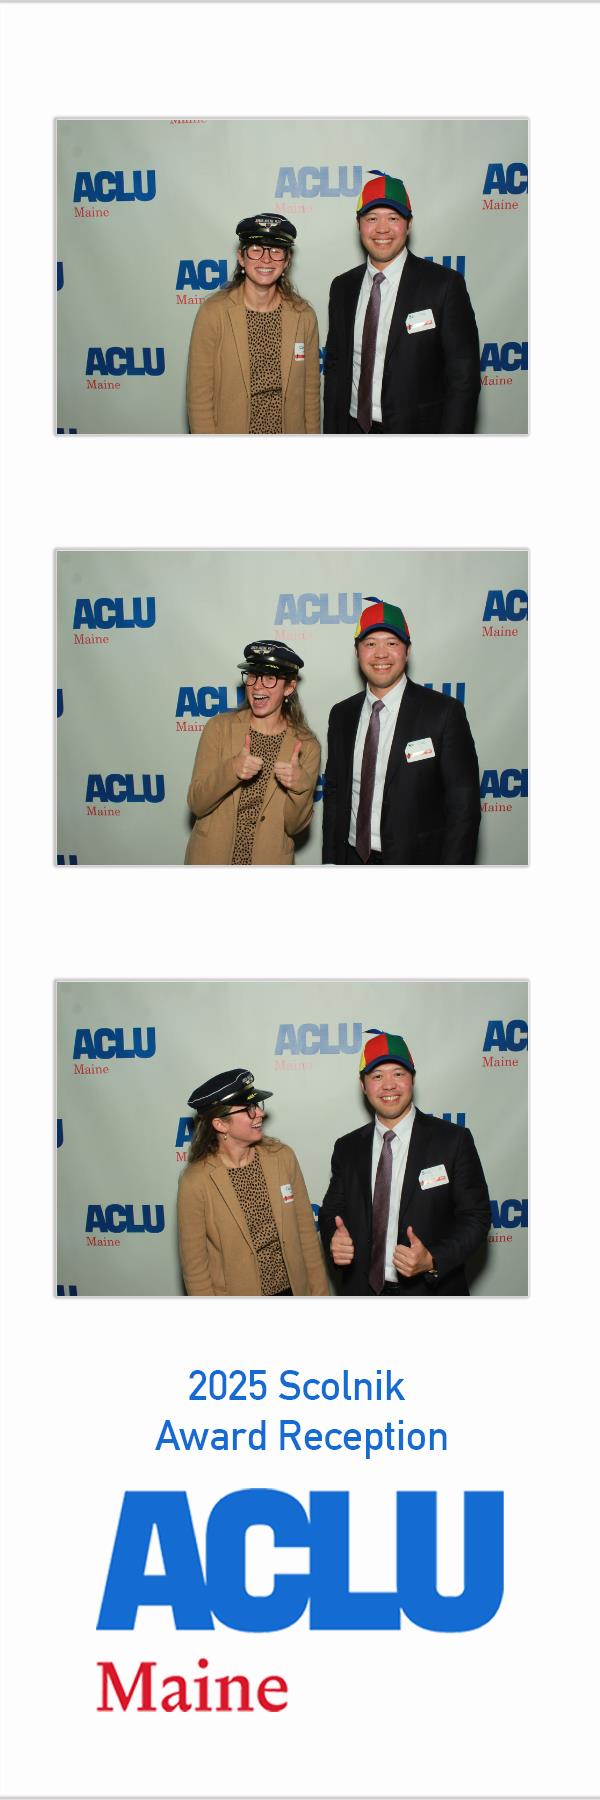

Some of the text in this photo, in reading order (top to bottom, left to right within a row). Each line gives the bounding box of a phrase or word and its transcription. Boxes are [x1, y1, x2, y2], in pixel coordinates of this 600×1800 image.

[73, 170, 156, 203] ACLU
[274, 165, 362, 198] ACLU
[482, 199, 519, 210] Maine
[74, 206, 109, 217] Maine
[176, 293, 207, 304] Main
[85, 347, 165, 376] ACLU
[86, 379, 121, 390] Maine
[73, 596, 156, 630] ACLU
[273, 592, 362, 625] ACLU
[482, 626, 518, 637] Maine
[74, 633, 109, 645] Maine
[85, 774, 165, 803] ACLU
[86, 806, 121, 817] Maine
[73, 1026, 156, 1060] ACLU
[274, 1022, 362, 1055] ACLU
[482, 1056, 519, 1068] Maine
[74, 1064, 109, 1075] Maine
[85, 1204, 165, 1233] ACLU
[86, 1236, 121, 1247] Maine
[488, 1232, 513, 1243] aine
